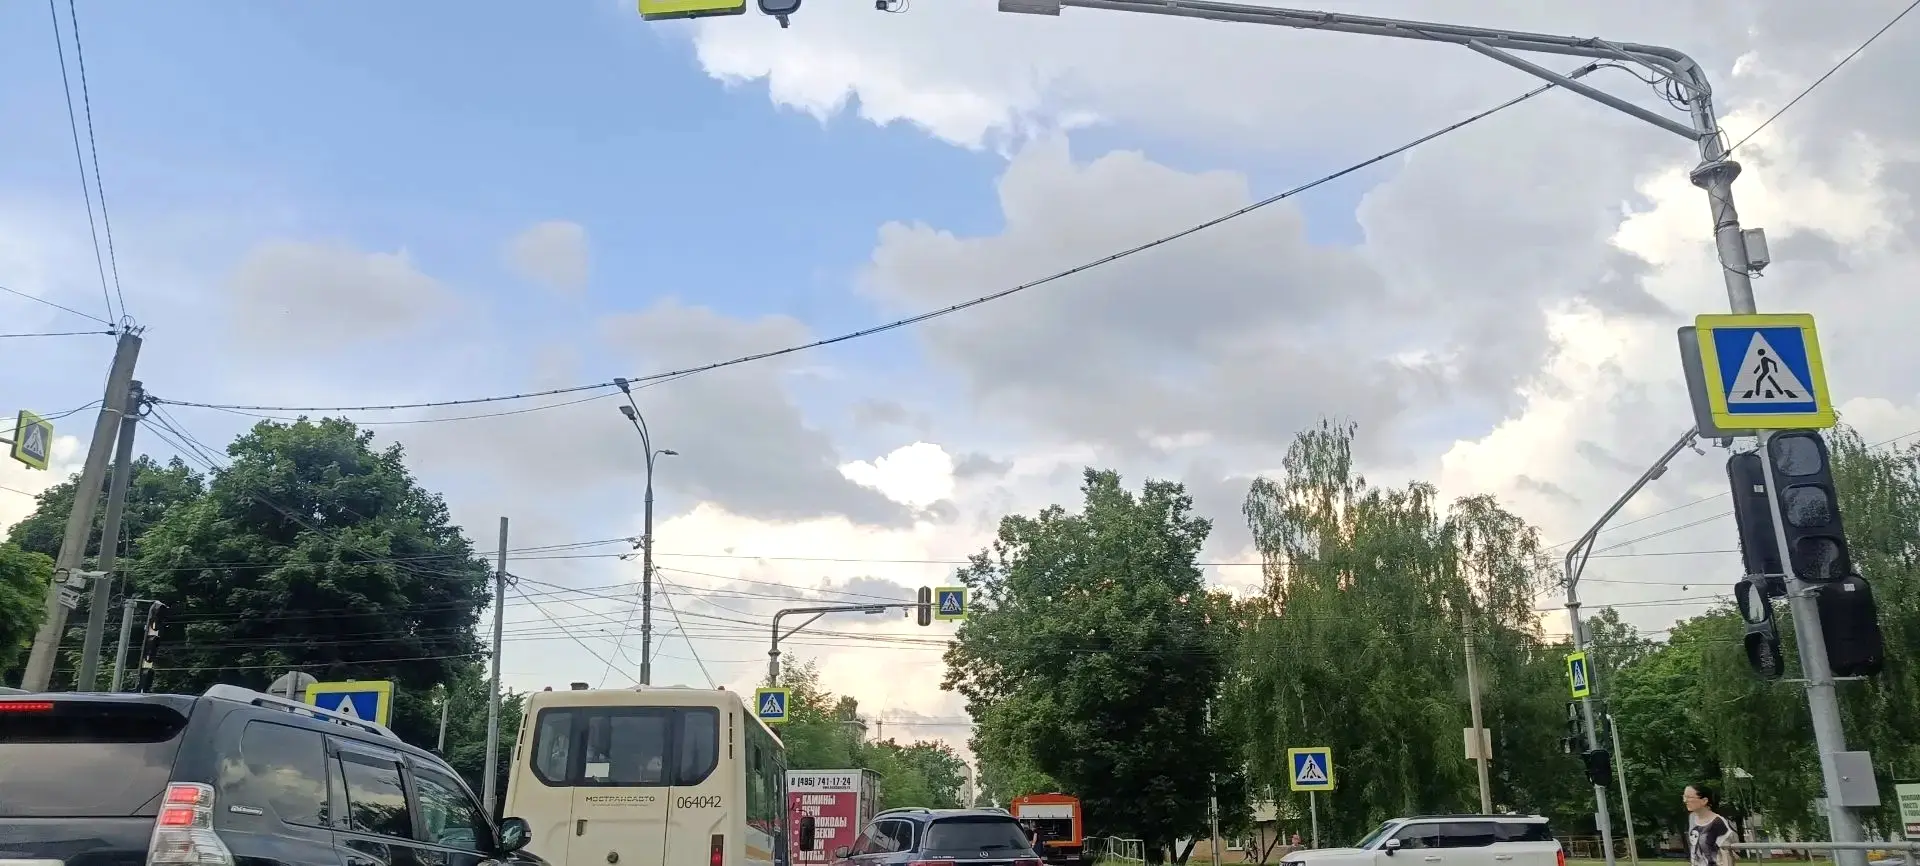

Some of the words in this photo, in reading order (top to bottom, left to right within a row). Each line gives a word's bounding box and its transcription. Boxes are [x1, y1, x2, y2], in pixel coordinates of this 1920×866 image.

[791, 777, 796, 786] 8
[797, 777, 815, 787] (495)
[817, 777, 851, 786] 741-17-24
[677, 795, 722, 809] 064042
[802, 794, 836, 805] КАМИНЫ
[801, 806, 821, 816] ПЕЧИ
[814, 816, 847, 827] МОХОДЫ
